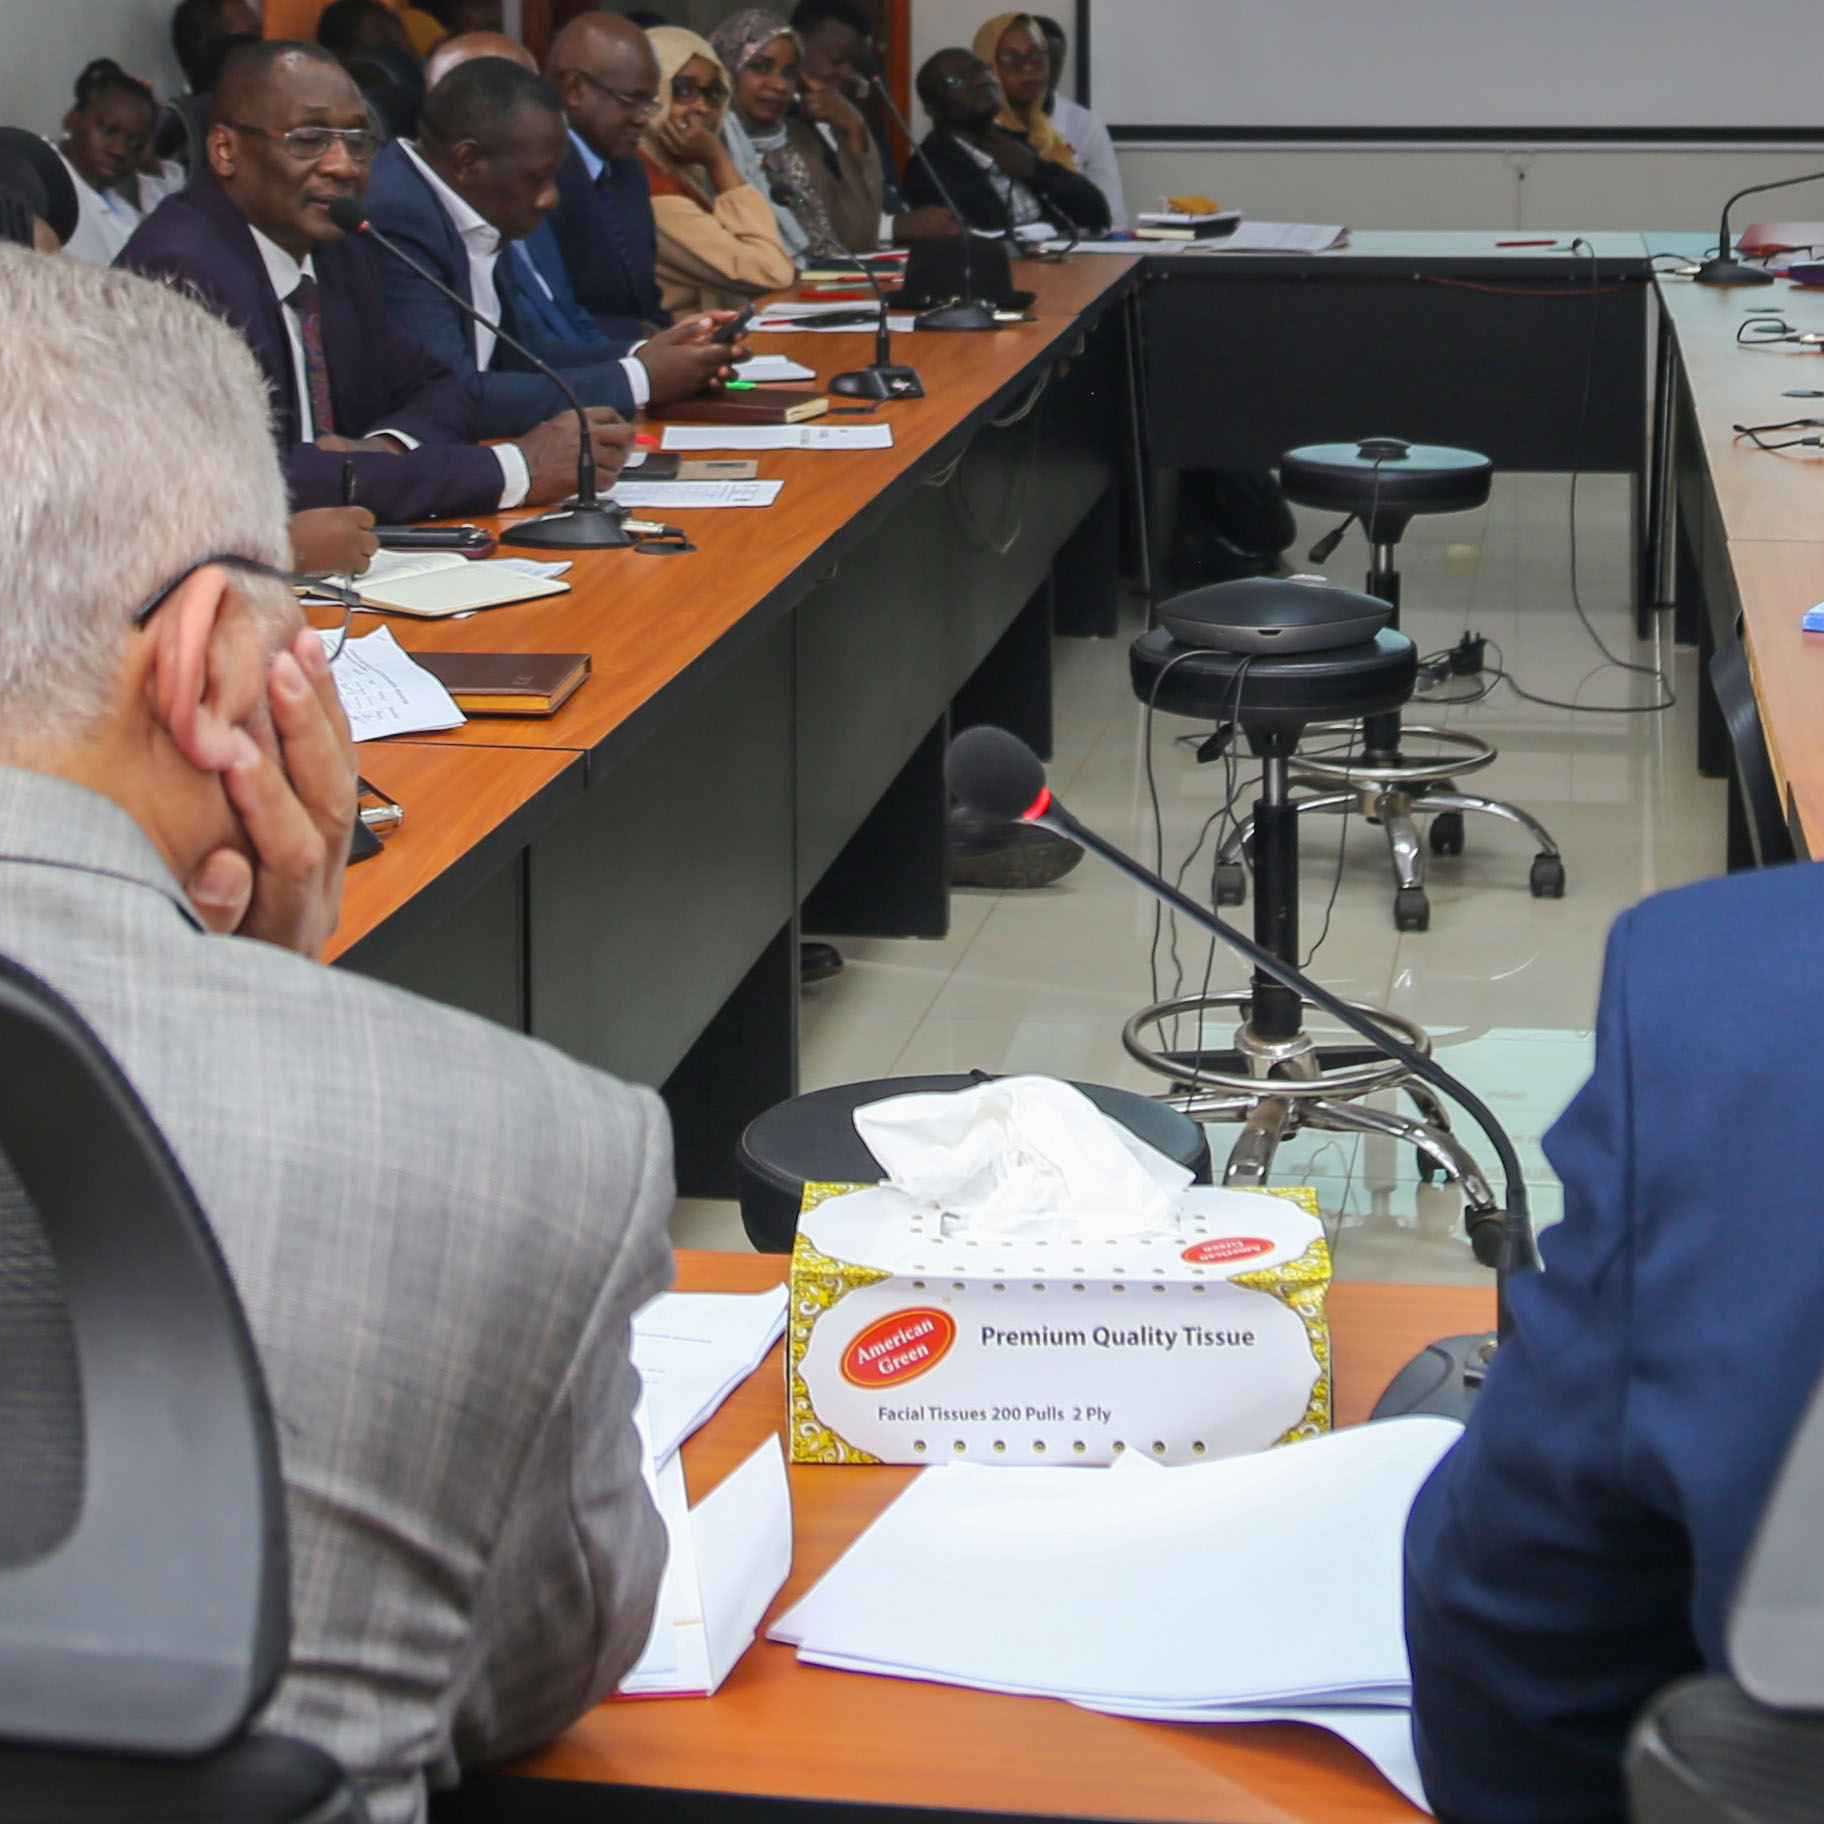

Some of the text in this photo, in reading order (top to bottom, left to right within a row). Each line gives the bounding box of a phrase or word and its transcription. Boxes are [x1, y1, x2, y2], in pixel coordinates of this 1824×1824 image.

[857, 1318, 935, 1365] American
[980, 1325, 1255, 1351] Premium Quality Tissue
[877, 1343, 930, 1375] Green
[878, 1405, 1112, 1426] Facial Tissues 200 Pulls 2 Ply
